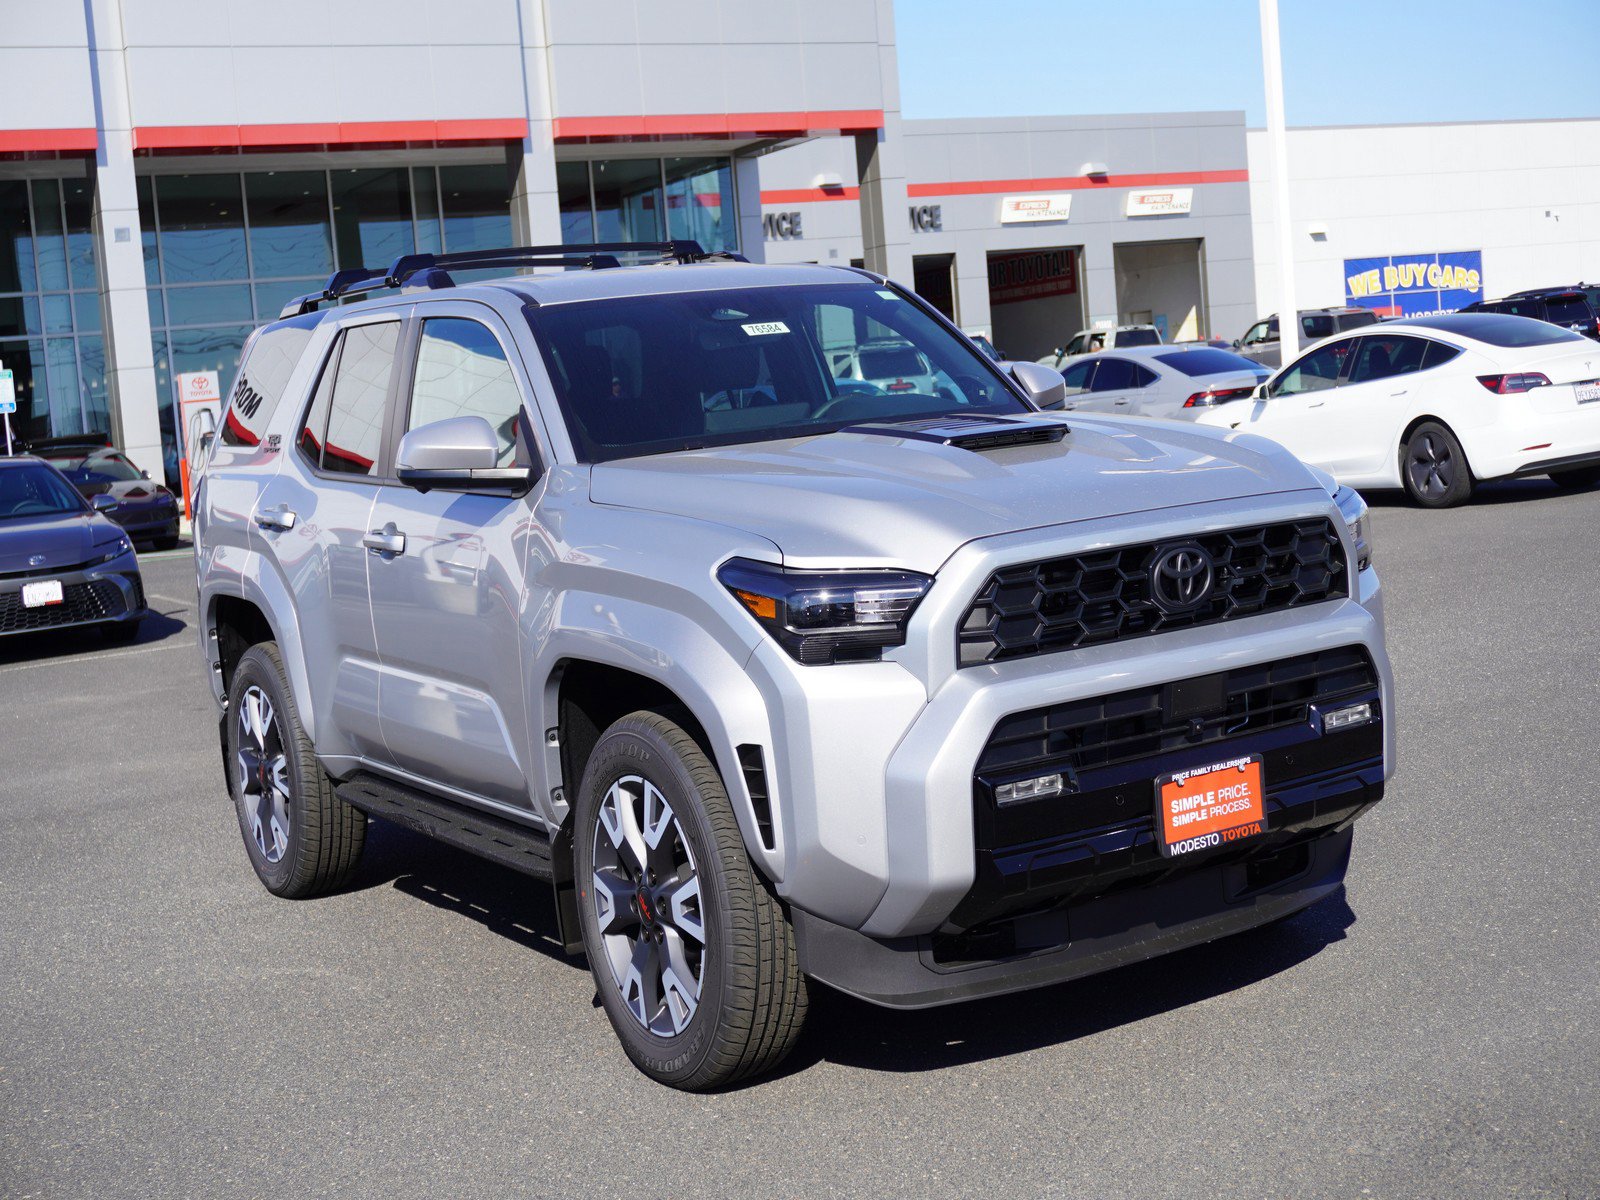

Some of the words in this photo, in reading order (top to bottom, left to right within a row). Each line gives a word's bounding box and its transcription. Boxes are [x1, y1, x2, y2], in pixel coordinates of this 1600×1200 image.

[1008, 250, 1071, 284] TOYOTA!!
[1347, 268, 1382, 298] WE
[1383, 263, 1427, 290] BUY
[1427, 263, 1480, 293] CARS
[747, 324, 782, 334] 76584
[190, 389, 213, 397] TOYOTA
[1171, 770, 1190, 782] PRICE
[1190, 765, 1212, 777] FAMILY
[1212, 756, 1251, 772] DEALERSHIPS
[1171, 791, 1215, 814] SIMPLE
[1217, 782, 1251, 803] PRICE.
[1172, 809, 1208, 827] SIMPLE
[1209, 798, 1252, 818] PROCESS.
[1170, 833, 1220, 857] MODESTO
[1221, 822, 1262, 842] TOYOTA
